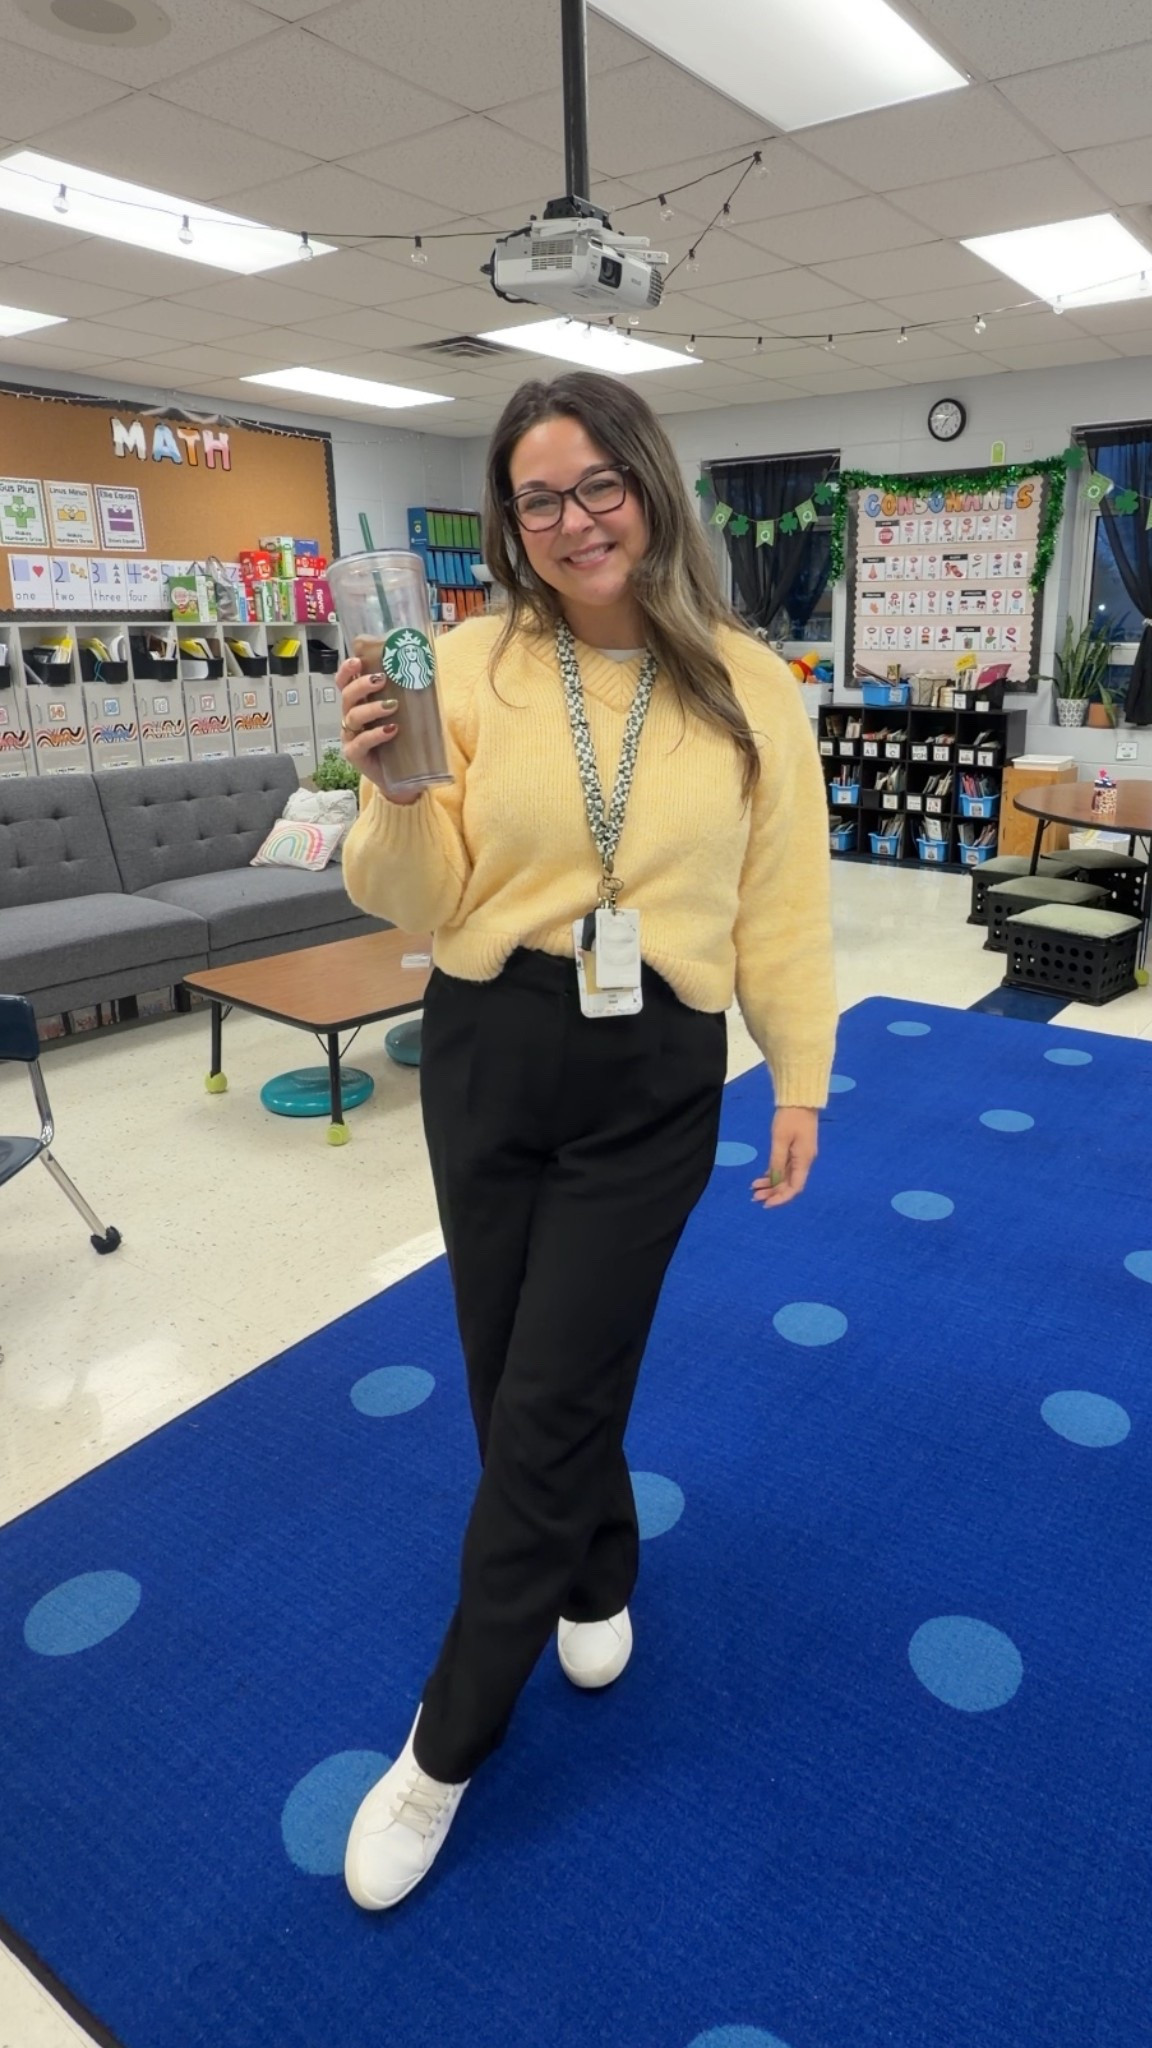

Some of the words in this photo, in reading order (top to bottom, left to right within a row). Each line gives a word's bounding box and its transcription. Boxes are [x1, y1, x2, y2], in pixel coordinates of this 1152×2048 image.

[110, 417, 231, 471] MATH
[17, 484, 35, 494] Plus
[864, 483, 1034, 517] CONSONANTS
[52, 560, 65, 583] 2
[92, 562, 100, 583] 3
[127, 563, 142, 584] 4
[226, 567, 237, 580] 7
[15, 592, 36, 601] one
[55, 590, 75, 601] two
[94, 590, 121, 602] three
[128, 590, 148, 601] four
[315, 589, 325, 614] flavor
